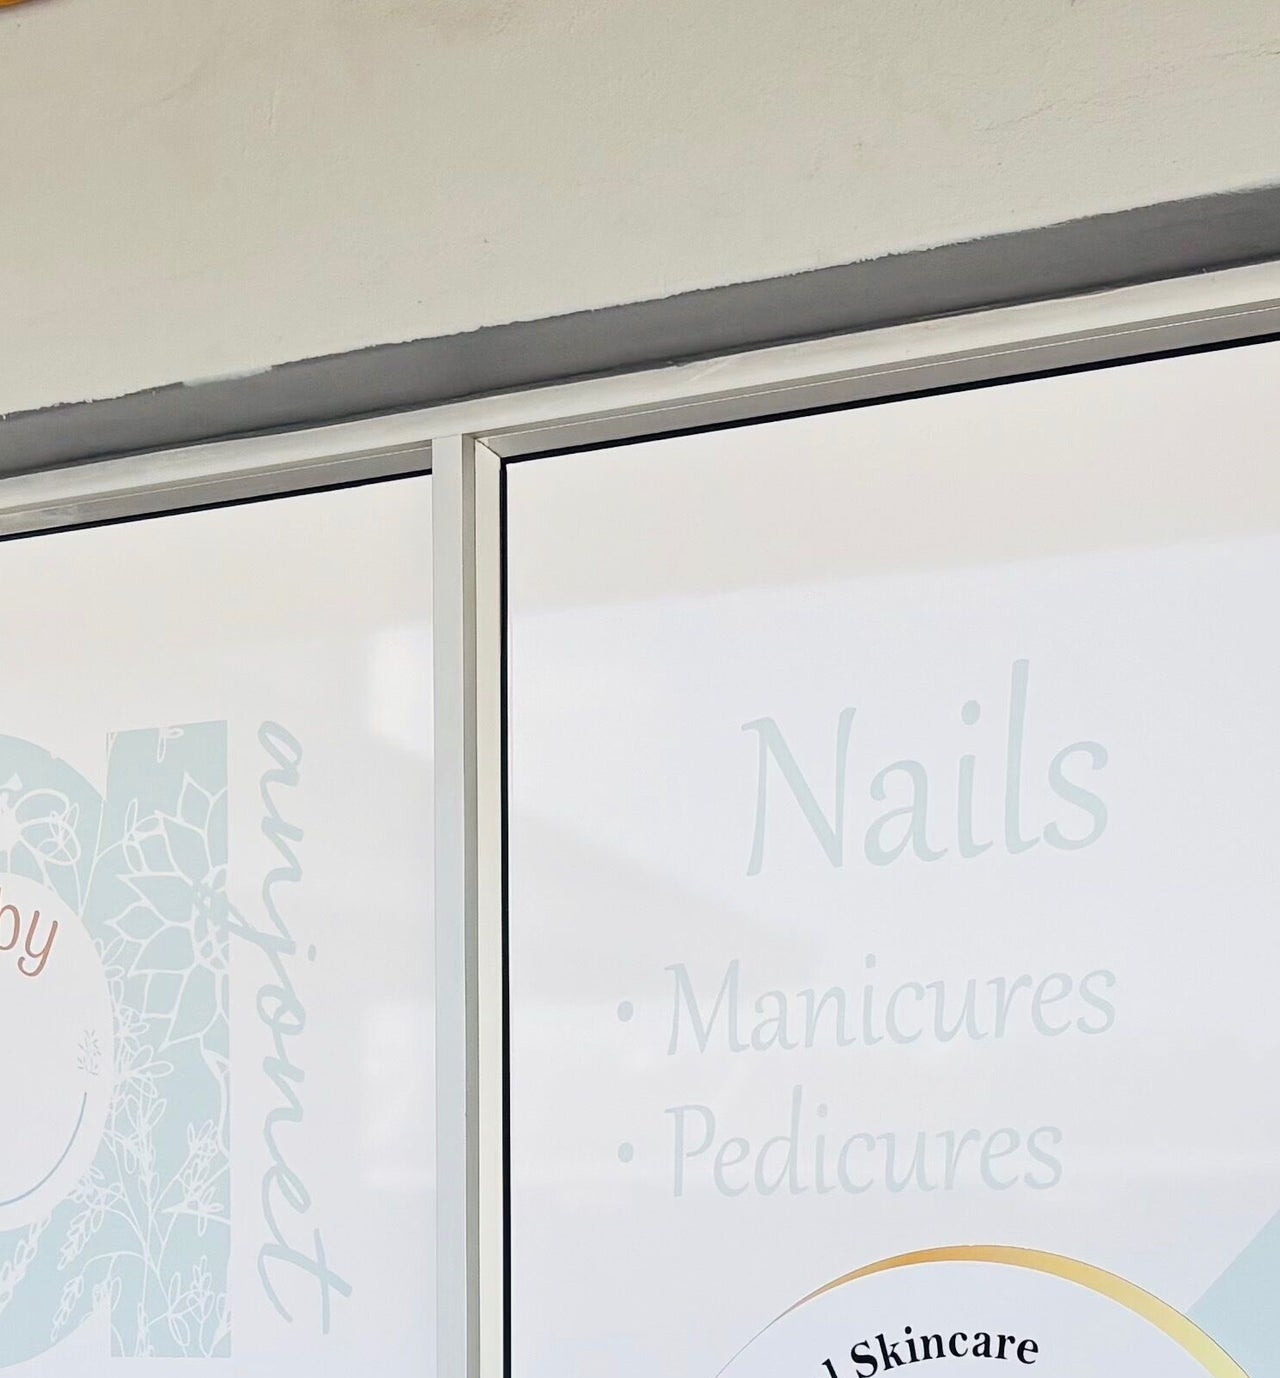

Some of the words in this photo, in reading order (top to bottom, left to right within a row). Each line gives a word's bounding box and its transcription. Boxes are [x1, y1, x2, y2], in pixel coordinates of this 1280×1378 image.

[739, 658, 1110, 877] Nails
[663, 952, 1119, 1056] Manicures
[663, 1083, 1065, 1199] Pedicures
